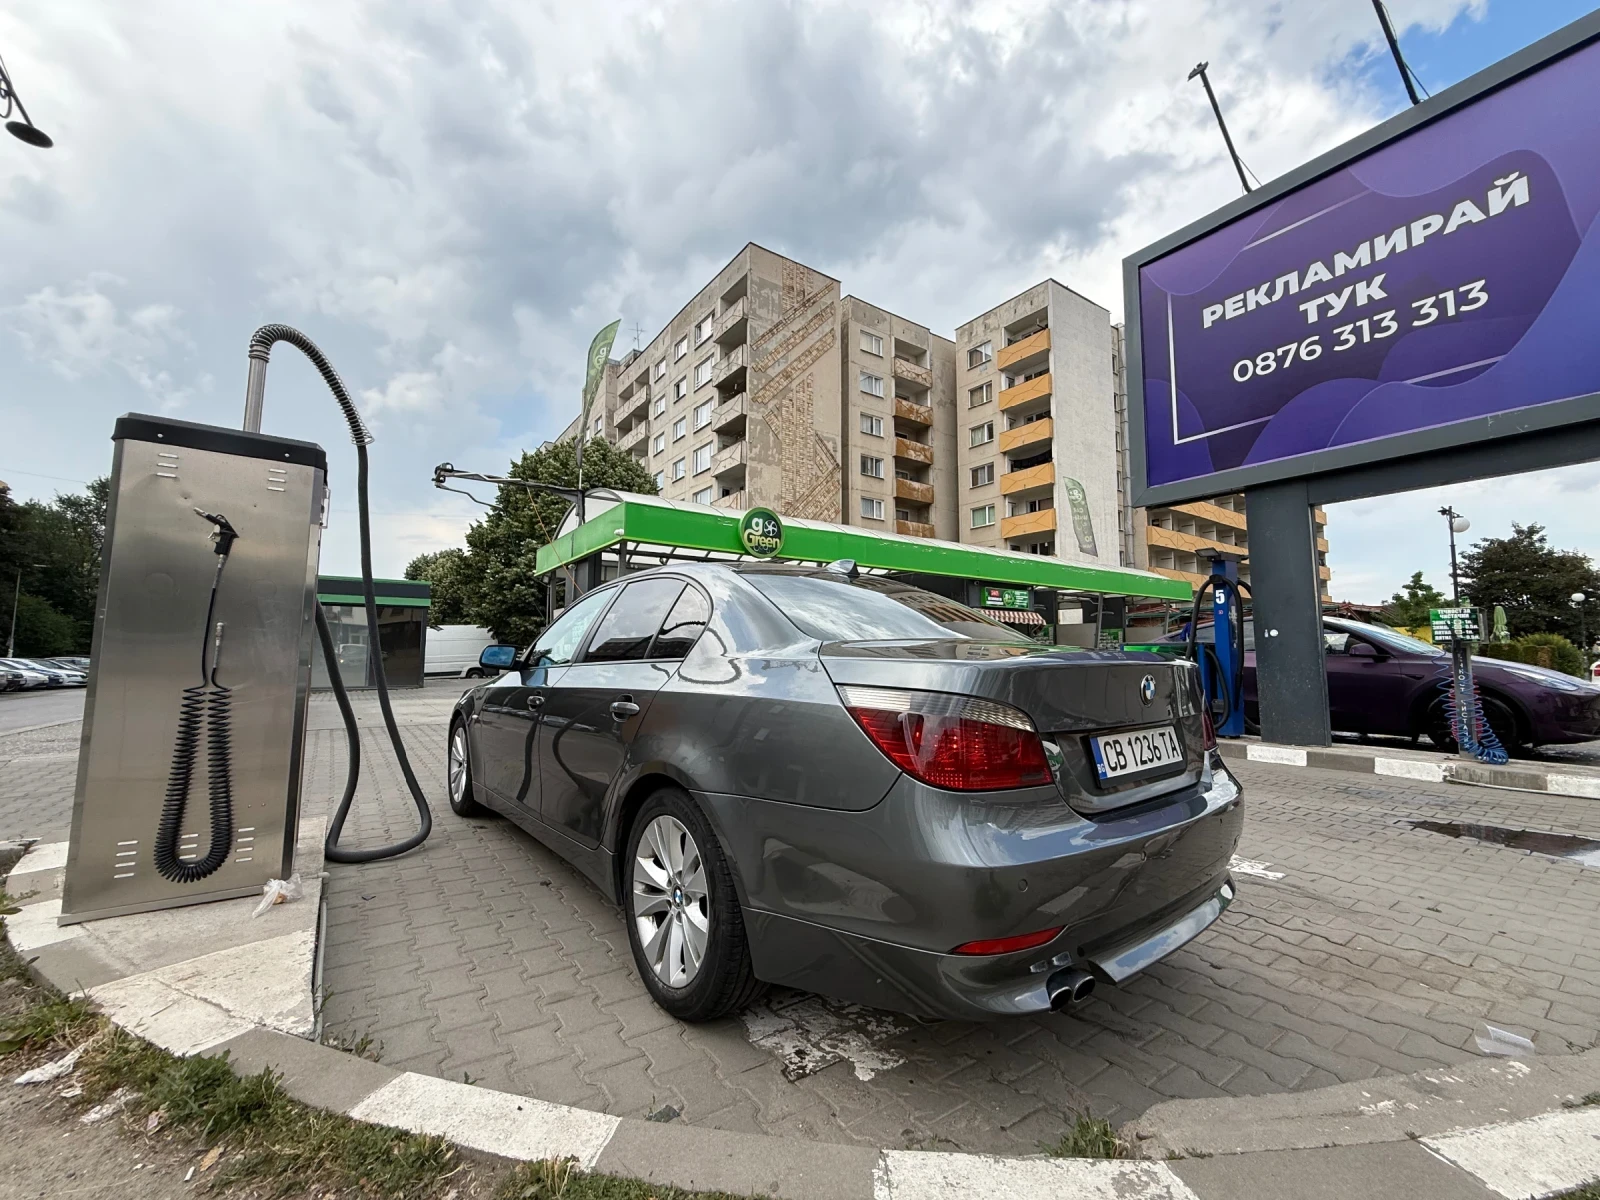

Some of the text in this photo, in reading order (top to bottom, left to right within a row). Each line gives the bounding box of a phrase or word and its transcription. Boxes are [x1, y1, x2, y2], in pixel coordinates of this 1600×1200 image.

[1203, 171, 1530, 329] РЕКЛАМИРАЙ
[1299, 273, 1388, 324] ТУК
[1233, 279, 1489, 382] 0876 313 313
[743, 528, 780, 549] Green
[1215, 589, 1225, 604] 5
[1103, 730, 1180, 772] CB 1236 TA
